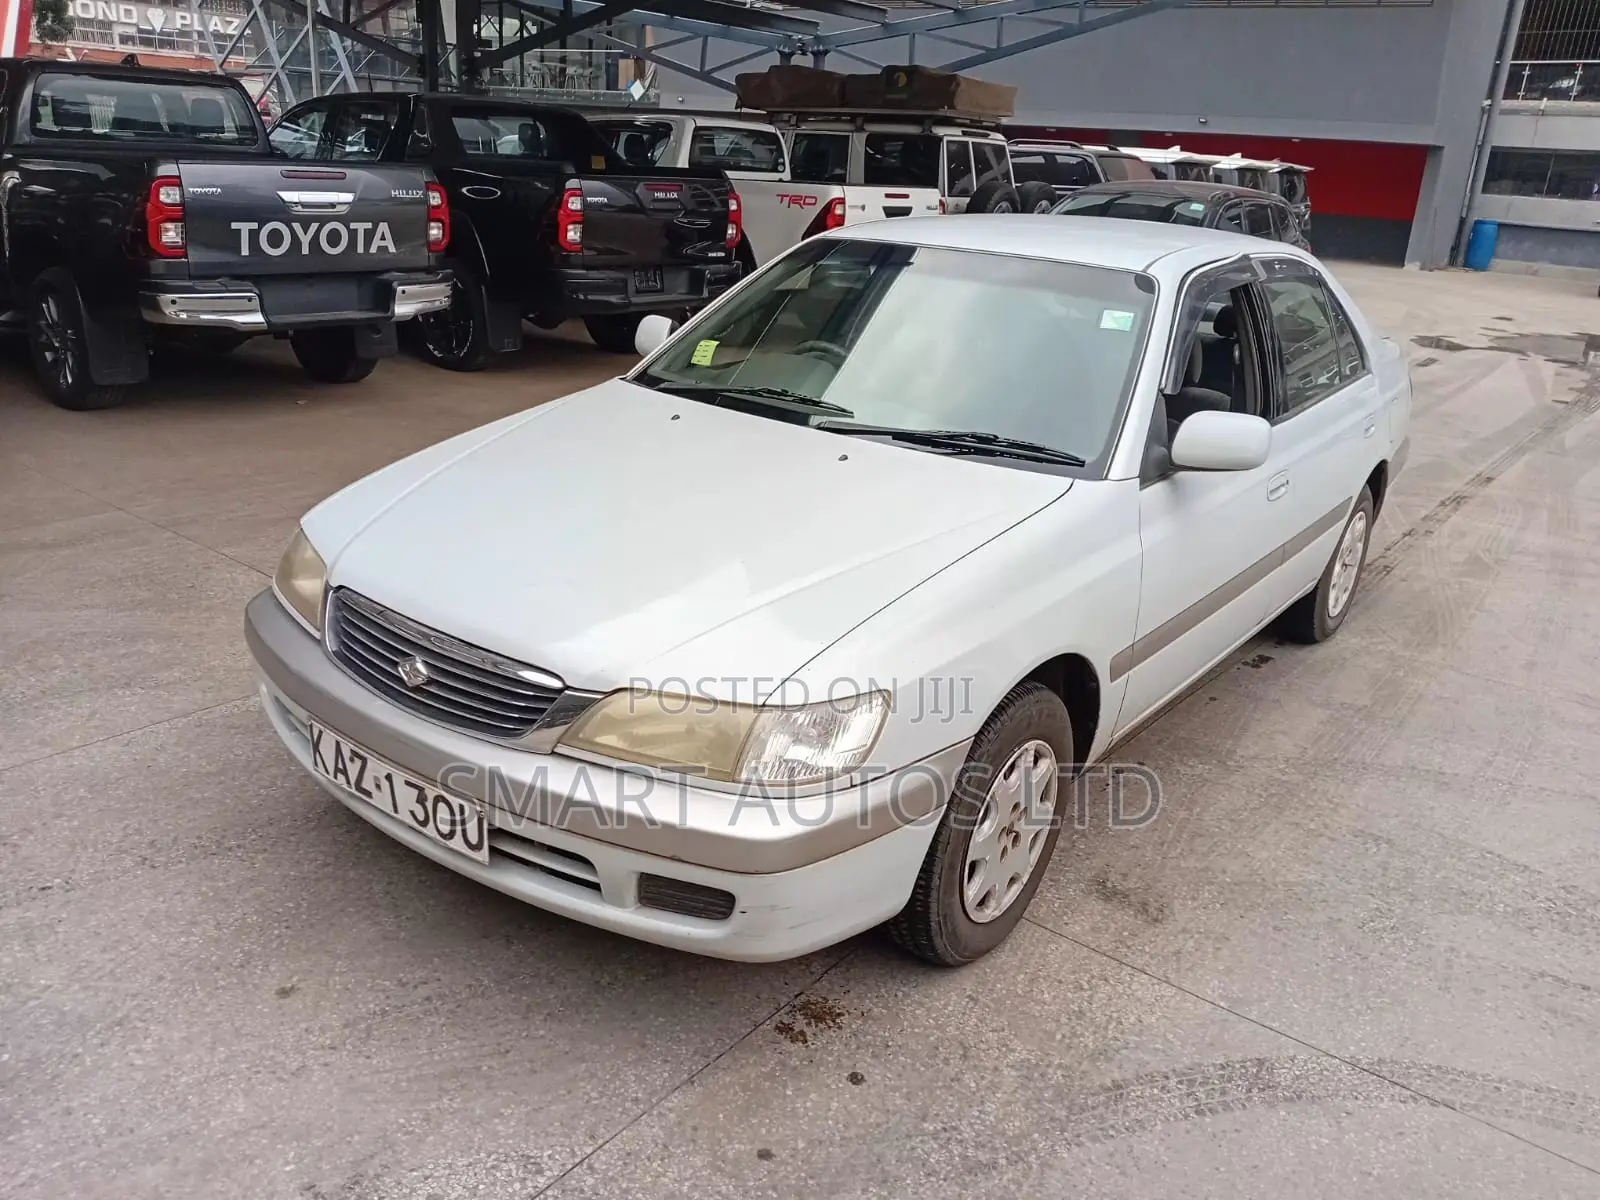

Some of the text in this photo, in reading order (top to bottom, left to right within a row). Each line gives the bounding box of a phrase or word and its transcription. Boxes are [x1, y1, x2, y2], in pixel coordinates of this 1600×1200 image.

[175, 11, 252, 36] PLAZ
[391, 189, 424, 198] HILUX
[775, 193, 818, 209] TRD
[230, 221, 397, 256] TOYOTA
